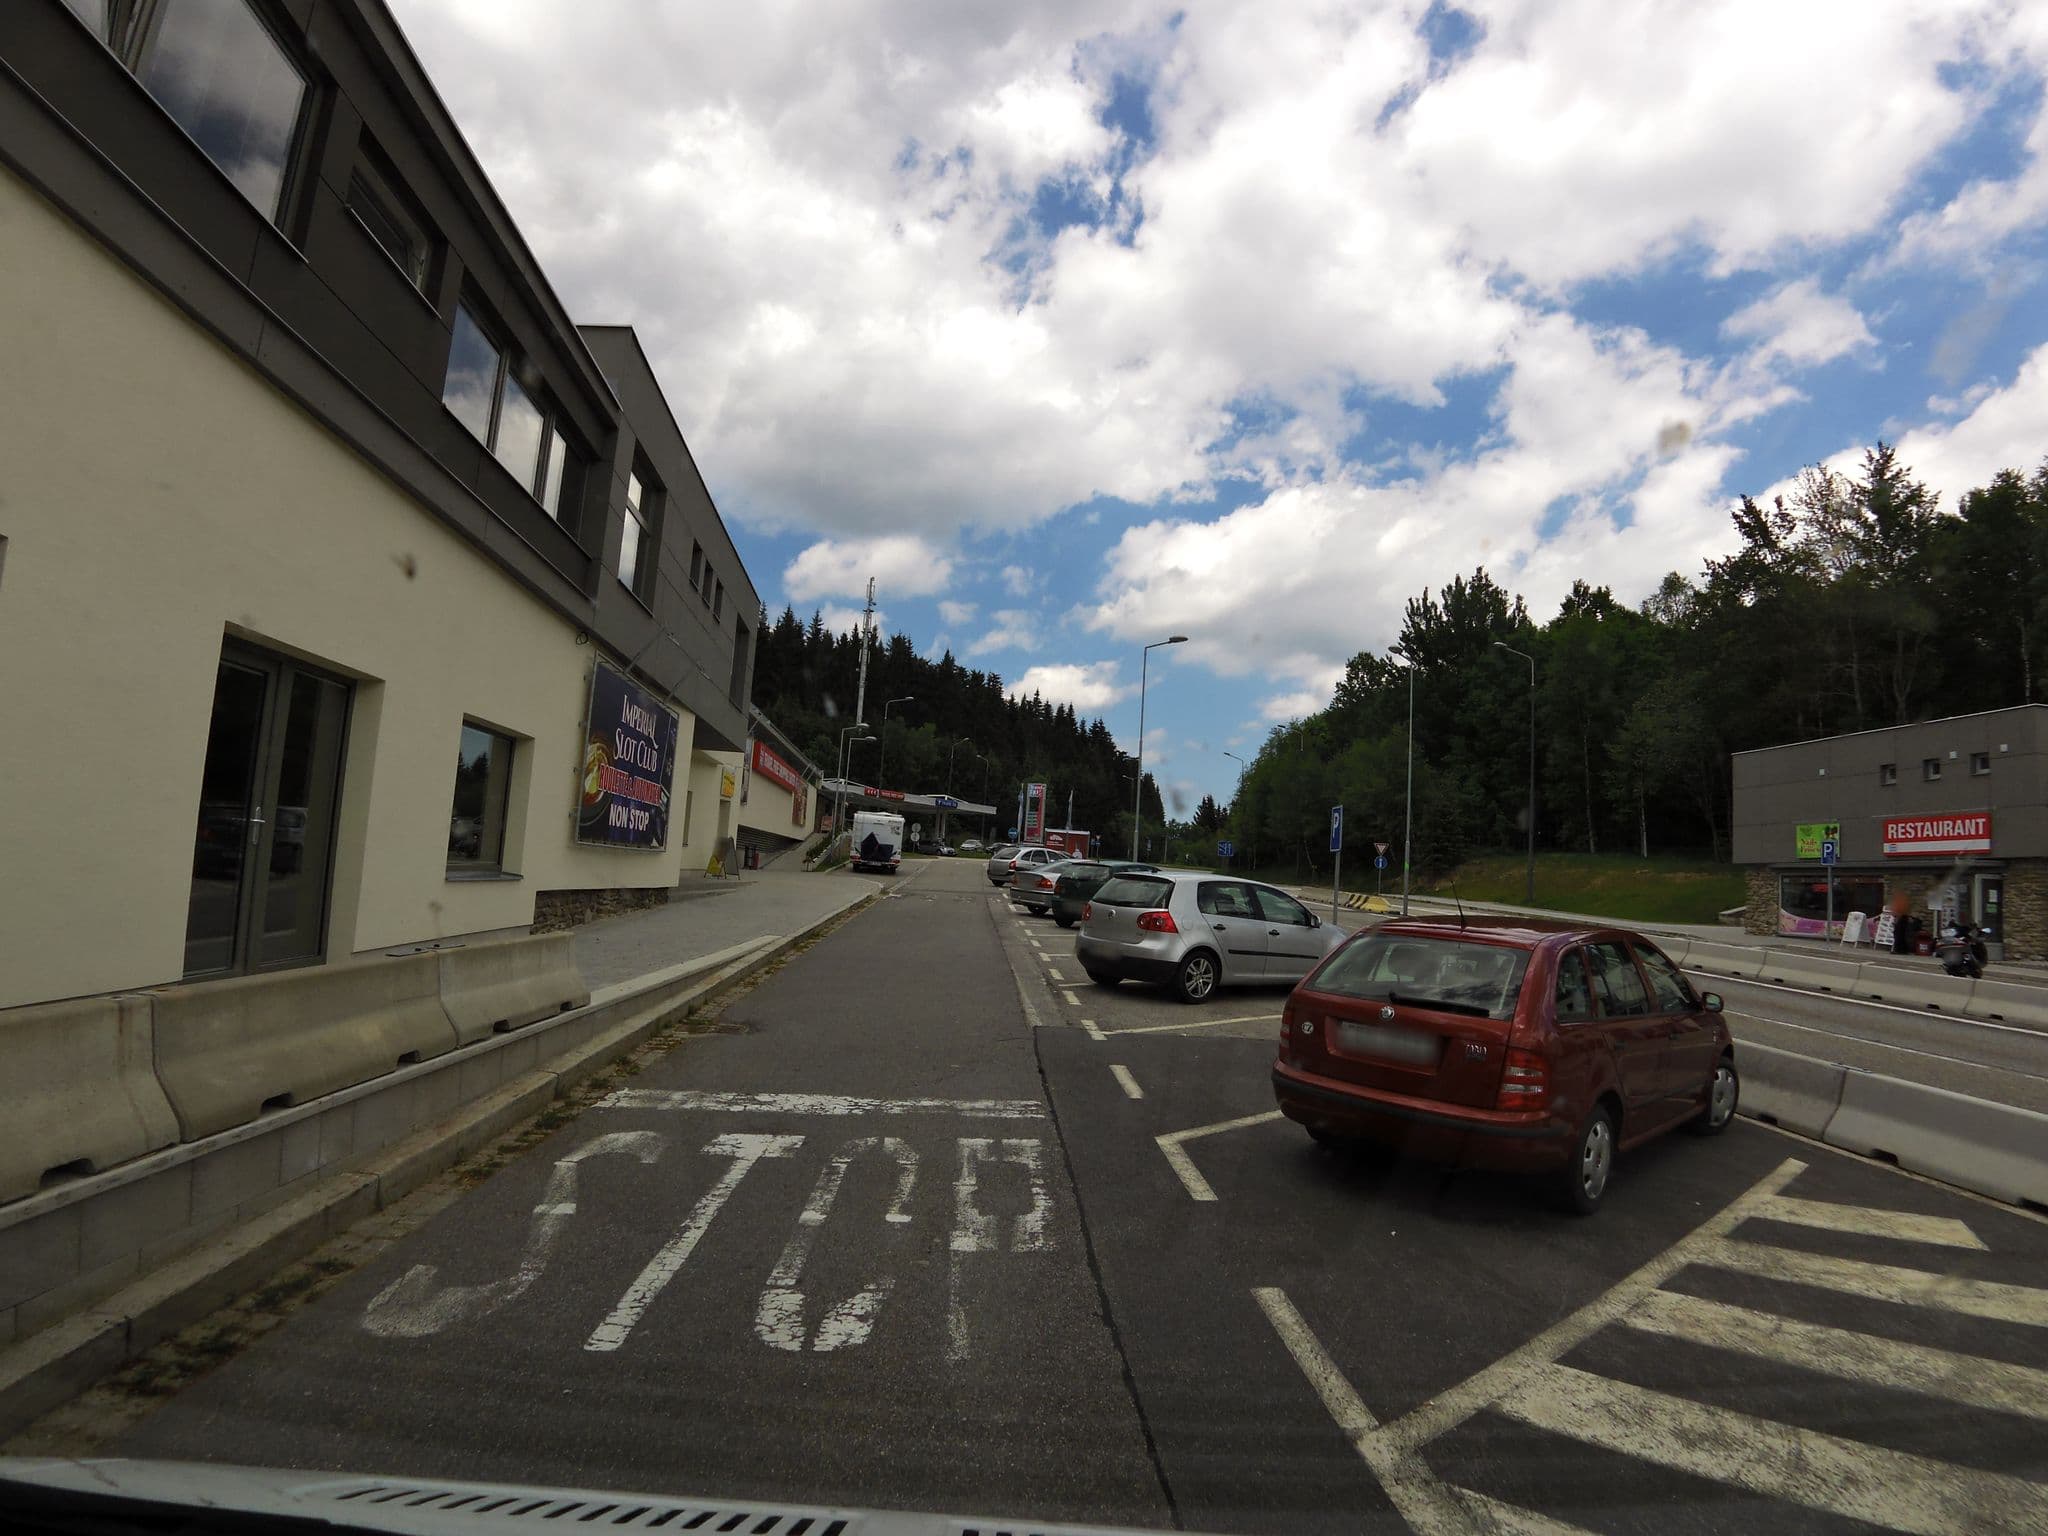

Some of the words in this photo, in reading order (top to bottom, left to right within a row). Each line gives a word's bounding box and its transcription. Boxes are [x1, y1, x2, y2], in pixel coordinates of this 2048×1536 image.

[622, 695, 659, 749] IMPERIAL
[614, 727, 635, 764] SLOT
[637, 739, 658, 772] CLUB
[608, 803, 628, 829] NON
[629, 809, 649, 832] STOP
[1887, 818, 1986, 839] RESTAURANT
[1823, 843, 1833, 857] P
[361, 1130, 1057, 1363] STOP
